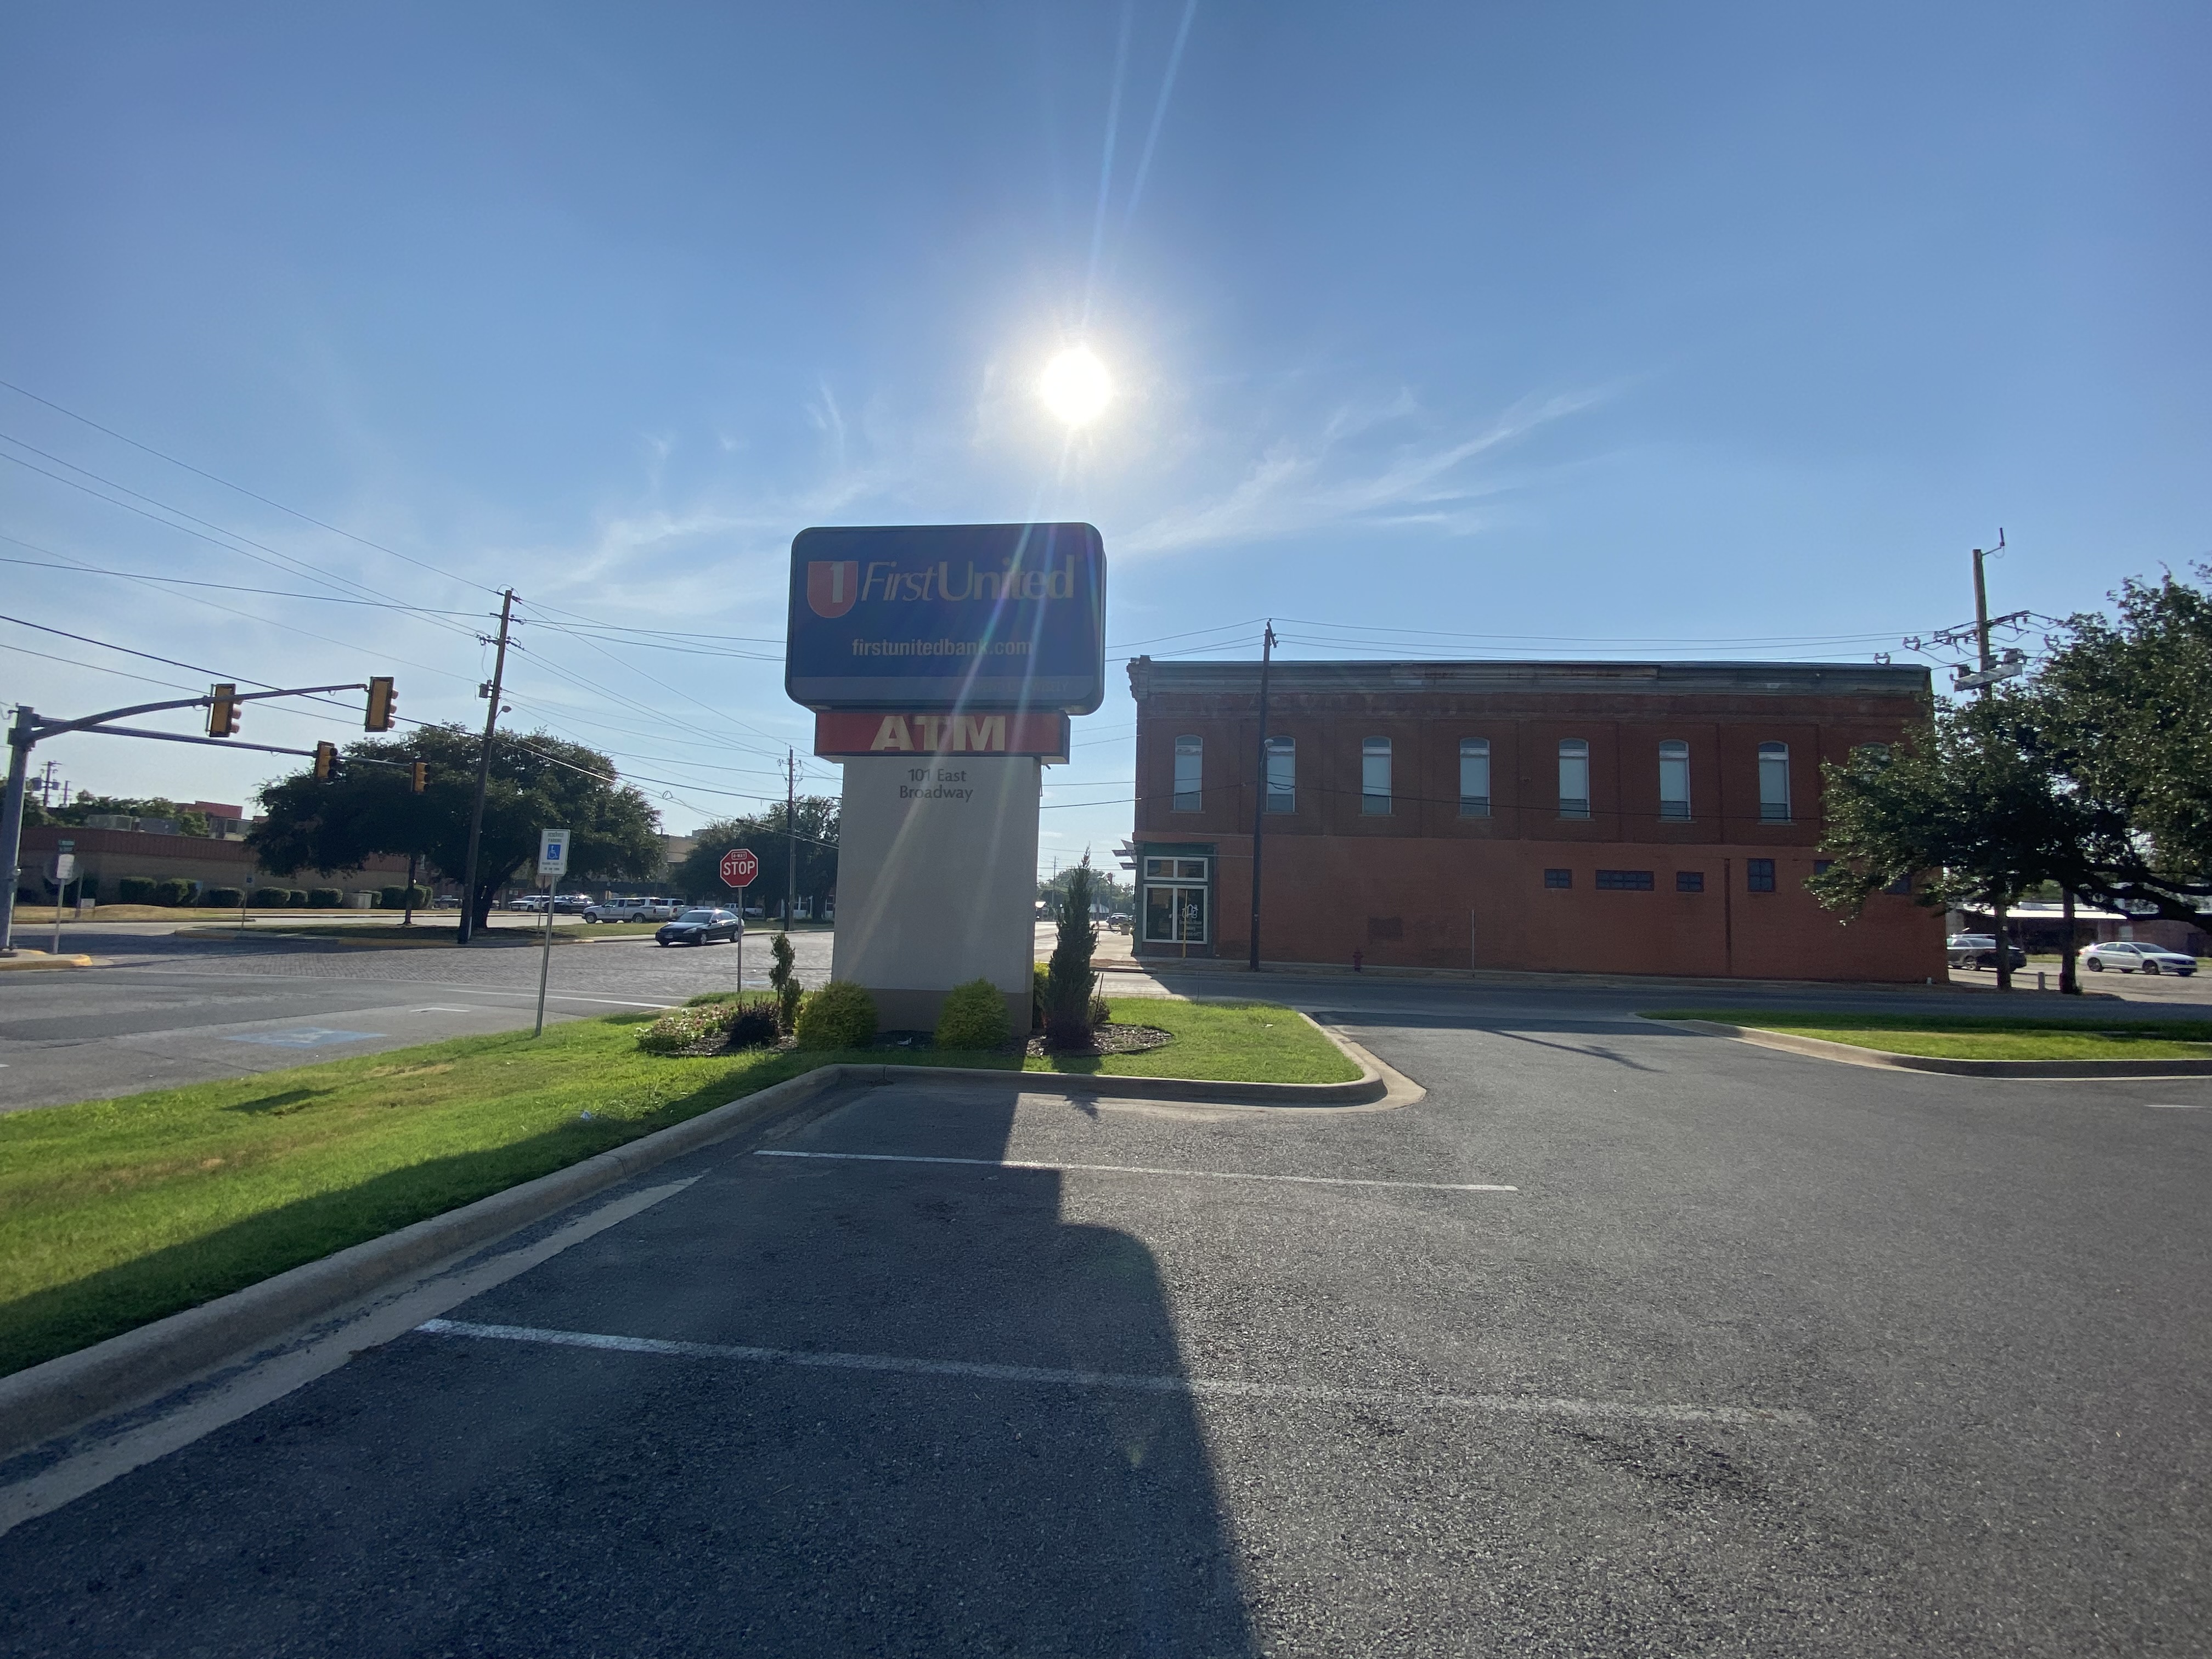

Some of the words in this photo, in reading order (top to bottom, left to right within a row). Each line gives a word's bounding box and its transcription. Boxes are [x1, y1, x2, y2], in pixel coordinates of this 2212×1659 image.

[851, 639, 1032, 656] firstunitedbank.com
[870, 715, 1006, 751] ATM
[908, 769, 930, 782] 101
[938, 769, 967, 782] East
[900, 785, 974, 803] Broadway
[723, 861, 755, 876] STOP
